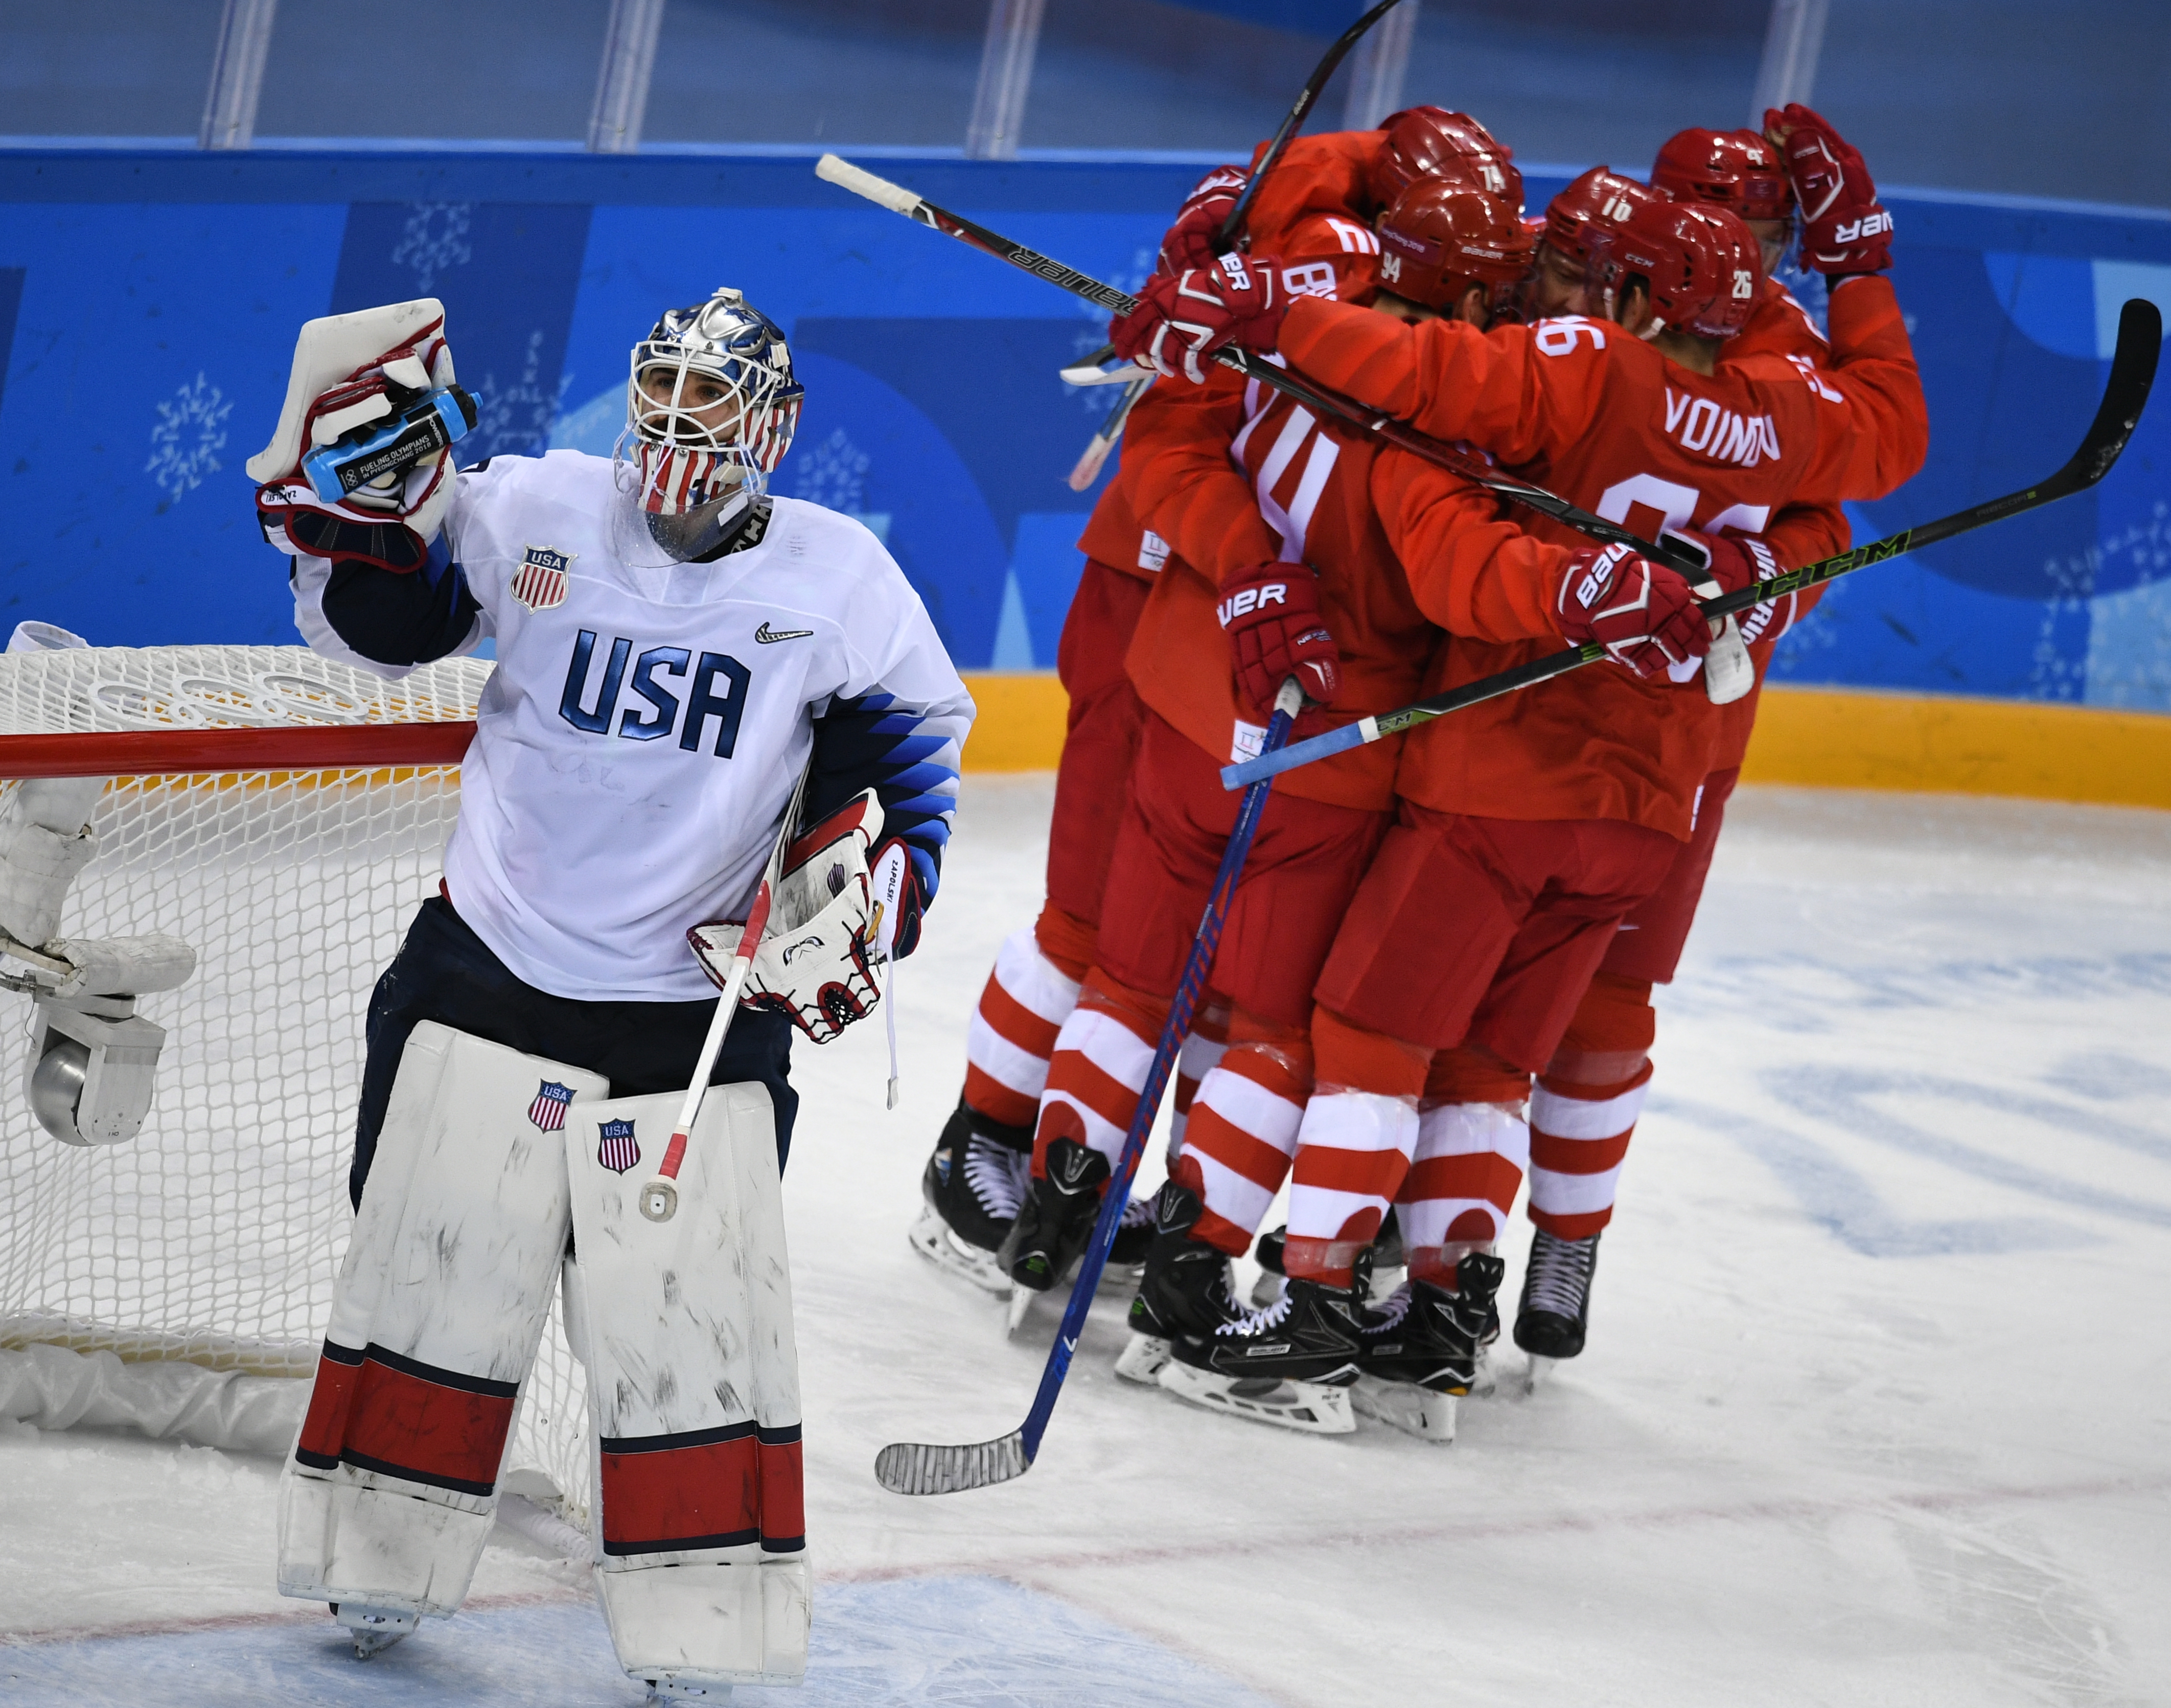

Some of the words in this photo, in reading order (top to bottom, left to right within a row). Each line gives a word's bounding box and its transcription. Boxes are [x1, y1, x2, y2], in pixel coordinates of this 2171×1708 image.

[1602, 197, 1633, 222] 10
[1381, 251, 1401, 284] 94
[1731, 269, 1752, 299] 26
[359, 454, 390, 474] FUELING
[390, 434, 430, 458] OLYMPIANS
[370, 450, 414, 476] PYEONGCHANG
[414, 442, 432, 455] 2018
[532, 552, 561, 569] USA
[1754, 528, 1912, 604] CCM
[558, 629, 752, 760] USA
[887, 859, 898, 904] ZAPOLSKI
[544, 1086, 567, 1101] USA
[605, 1125, 629, 1137] USA
